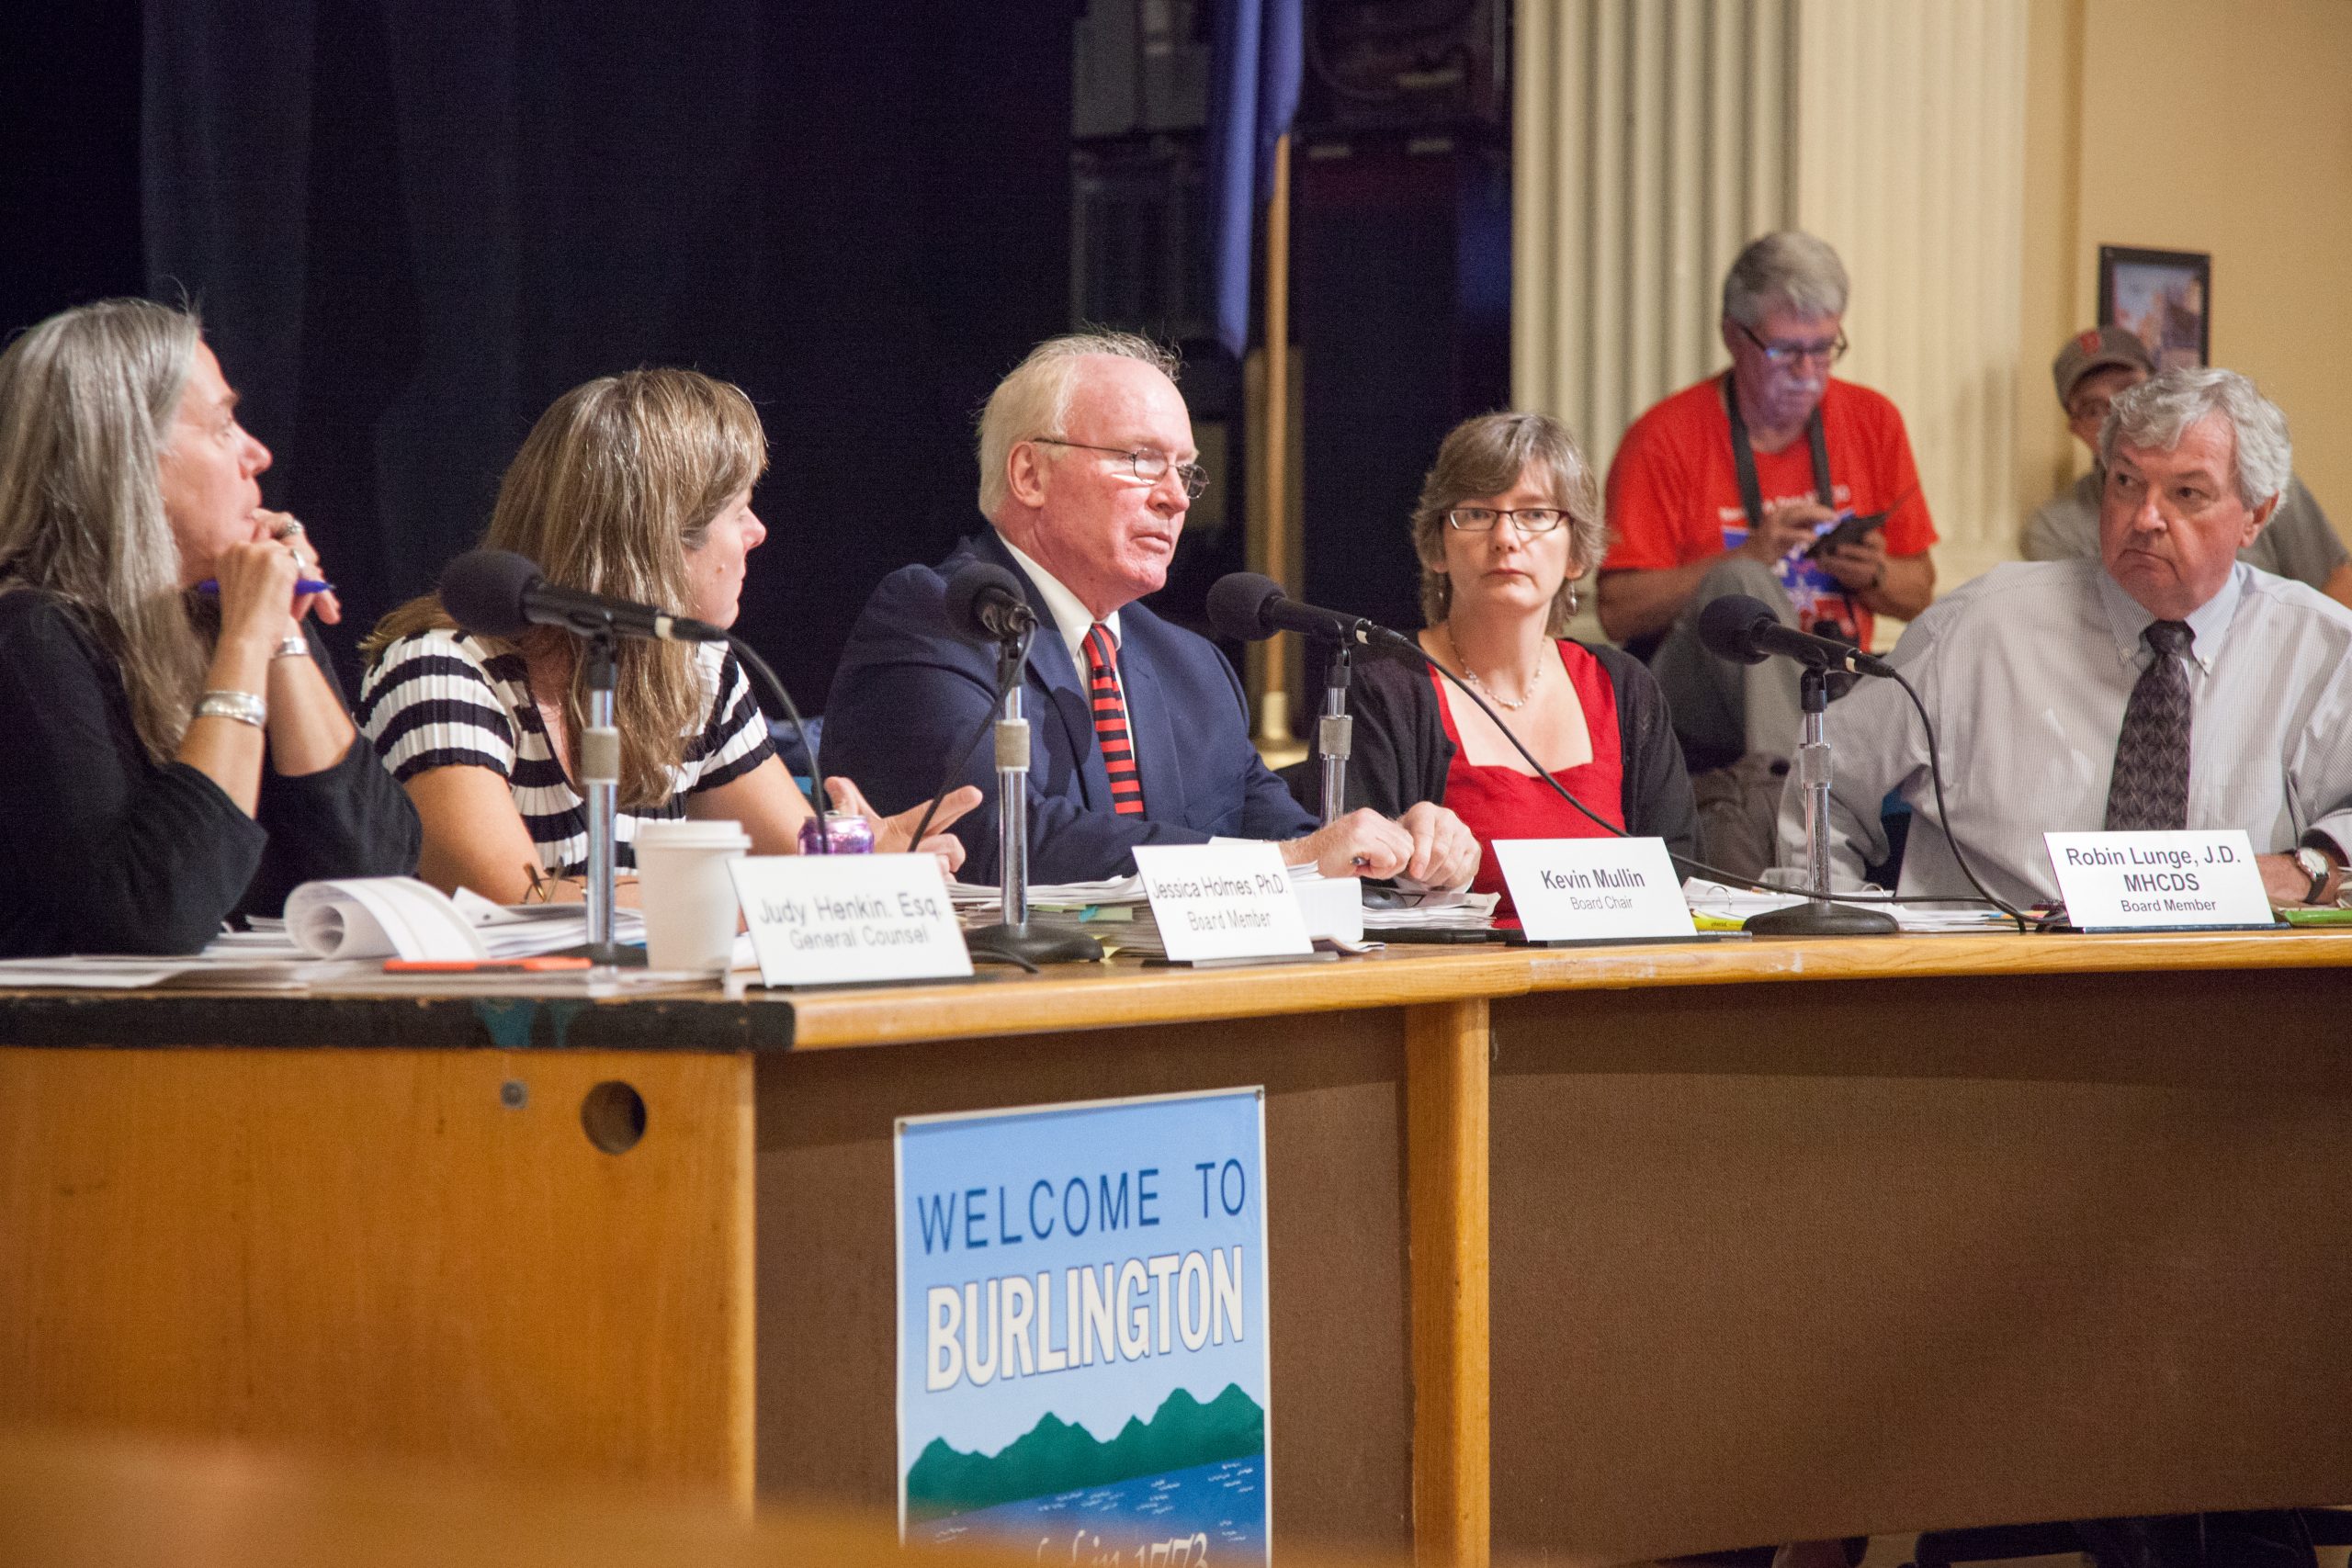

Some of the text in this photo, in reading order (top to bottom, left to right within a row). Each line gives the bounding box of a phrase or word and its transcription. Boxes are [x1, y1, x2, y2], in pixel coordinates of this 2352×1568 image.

[2066, 845, 2241, 868] Robin Lunge, J.D.
[1152, 877, 1198, 900] Jessica
[1201, 875, 1256, 898] Holmes,
[1541, 868, 1645, 889] Kevin Mullin
[2123, 874, 2200, 892] MHCDS
[759, 897, 806, 926] Judy
[1570, 896, 1633, 910] Board Chair
[2120, 898, 2216, 912] Board Member
[1187, 910, 1272, 931] Board Member
[790, 923, 930, 951] General Counsel
[917, 1157, 1246, 1256] WELCOME TO
[925, 1245, 1244, 1393] BURLINGTON
